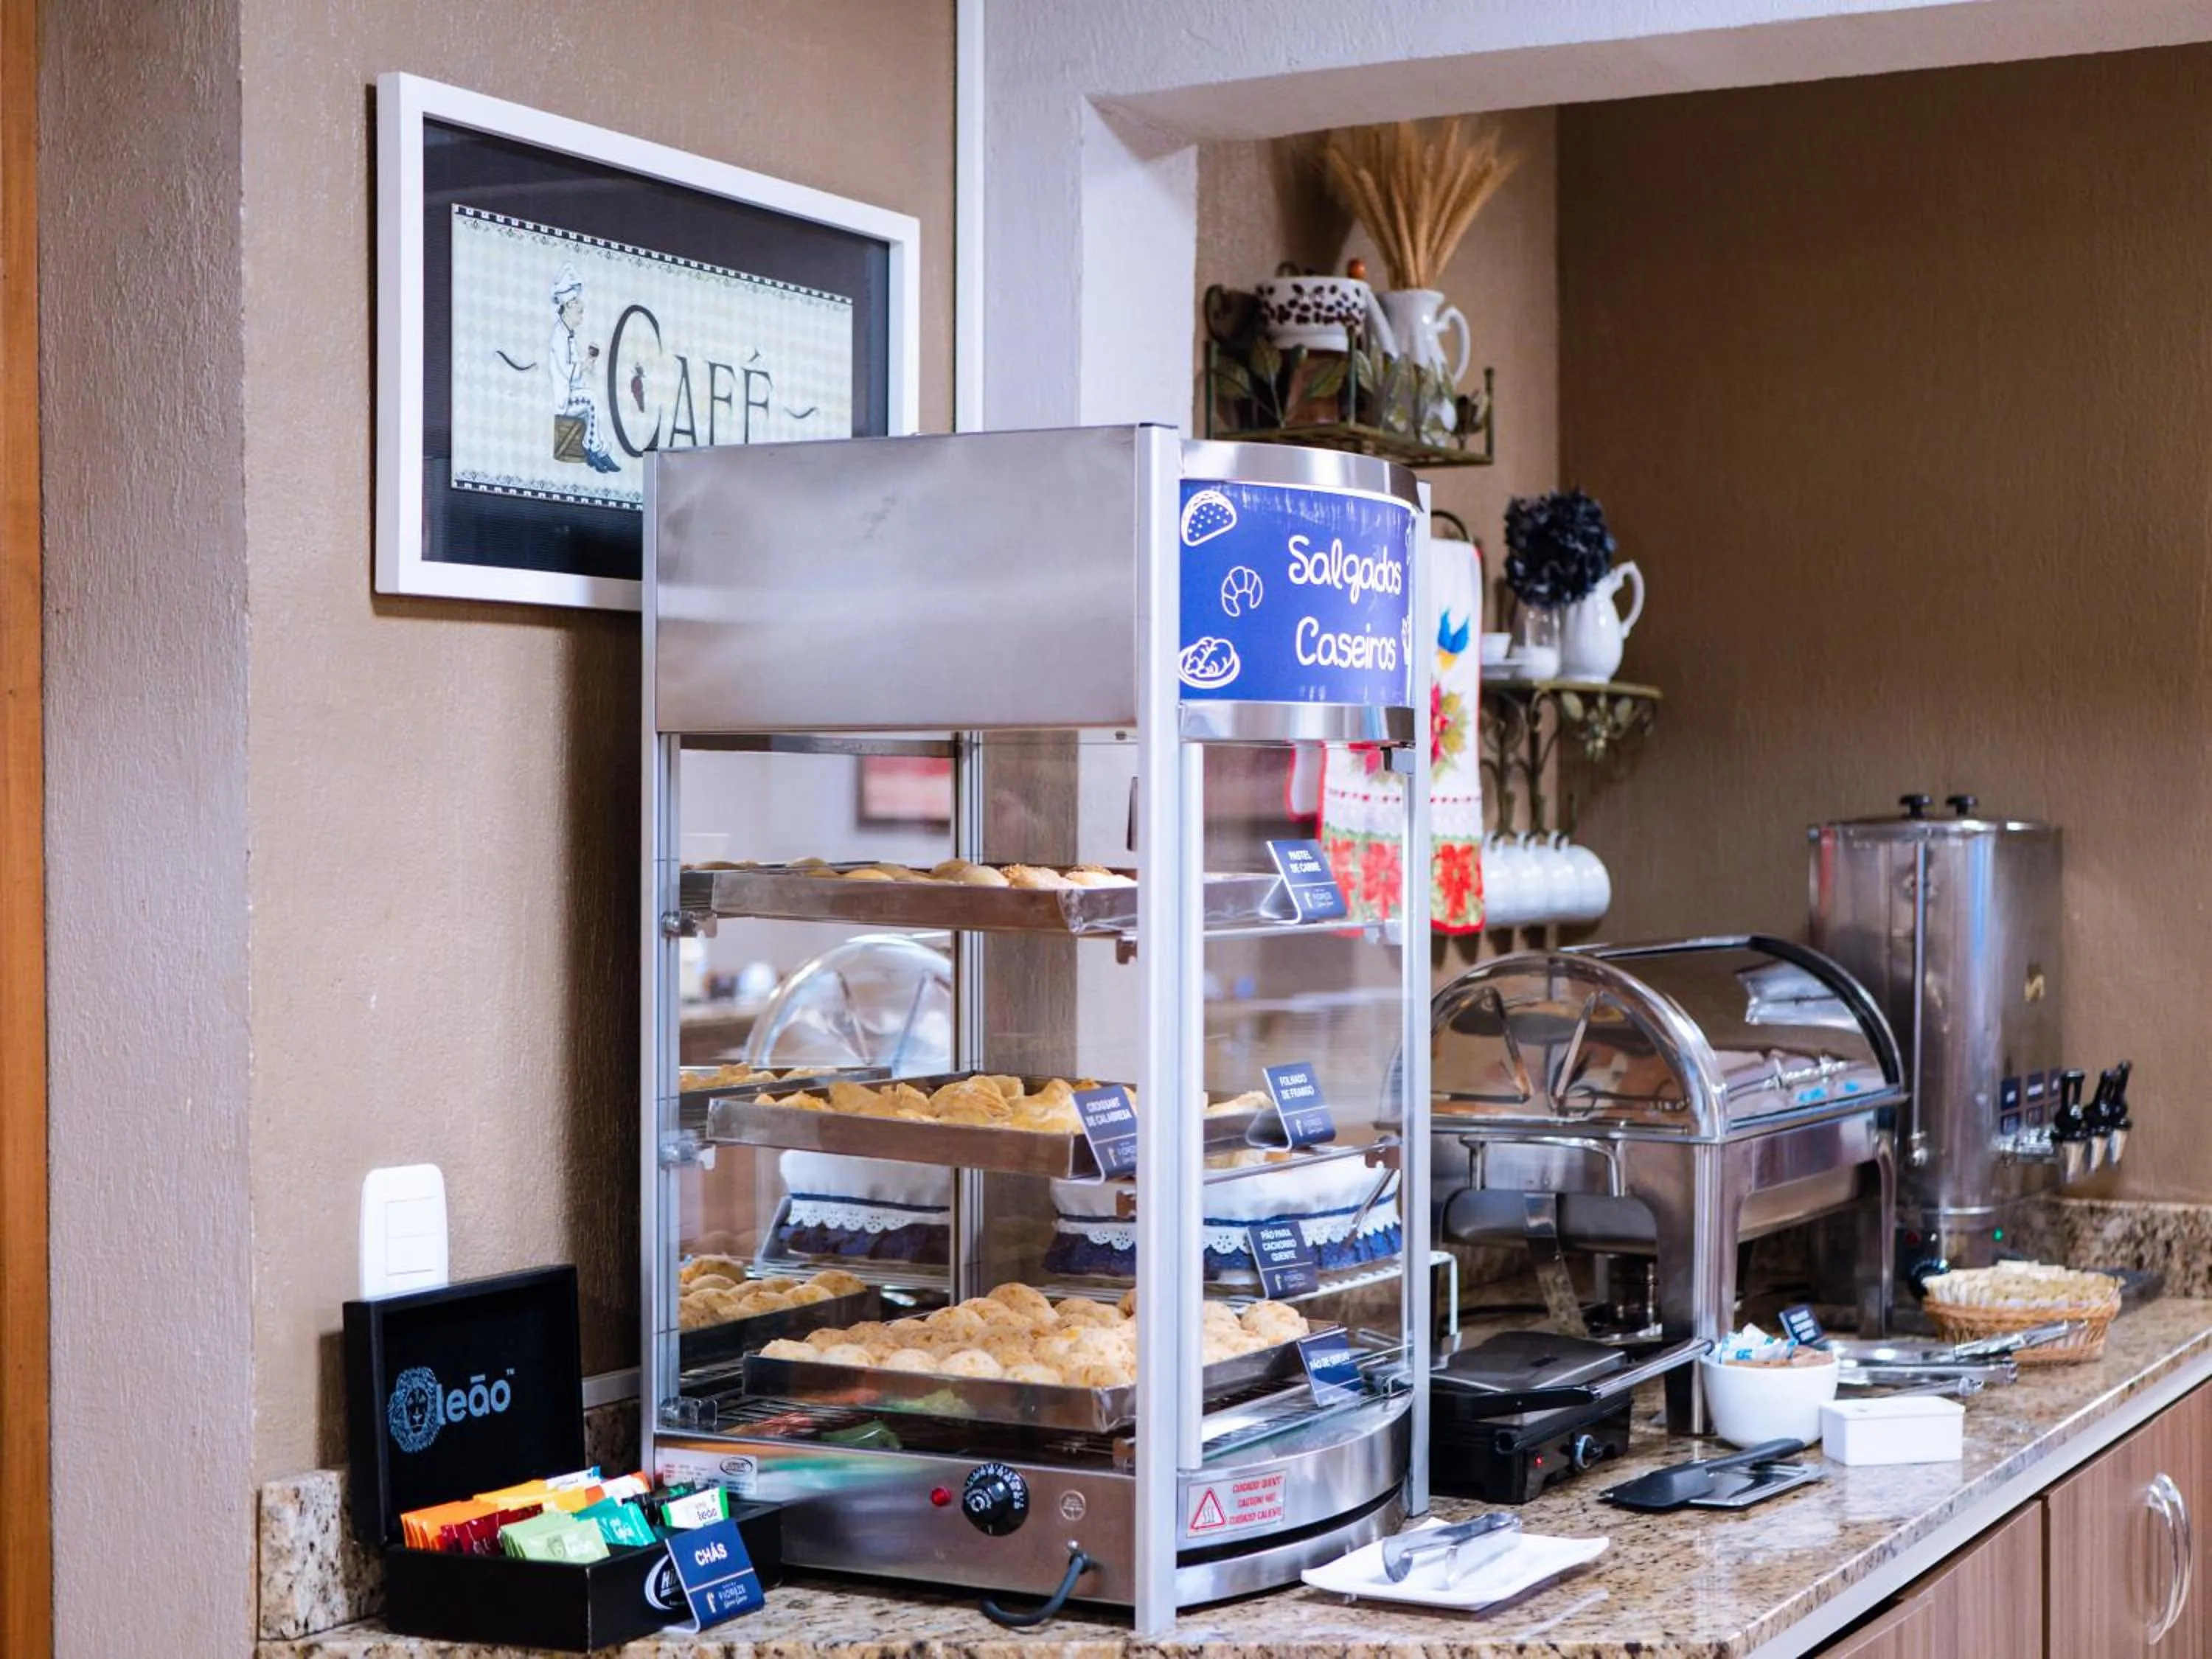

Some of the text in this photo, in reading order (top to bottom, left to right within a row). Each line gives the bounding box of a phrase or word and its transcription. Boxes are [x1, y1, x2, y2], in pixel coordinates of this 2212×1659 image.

[607, 304, 773, 459] CAFÉ
[1288, 535, 1402, 604] Salgados
[1295, 616, 1396, 672] Caseiros
[1288, 850, 1312, 860] PASTEL
[1279, 1073, 1307, 1087] FOLHADO
[695, 1542, 728, 1566] CHÁS
